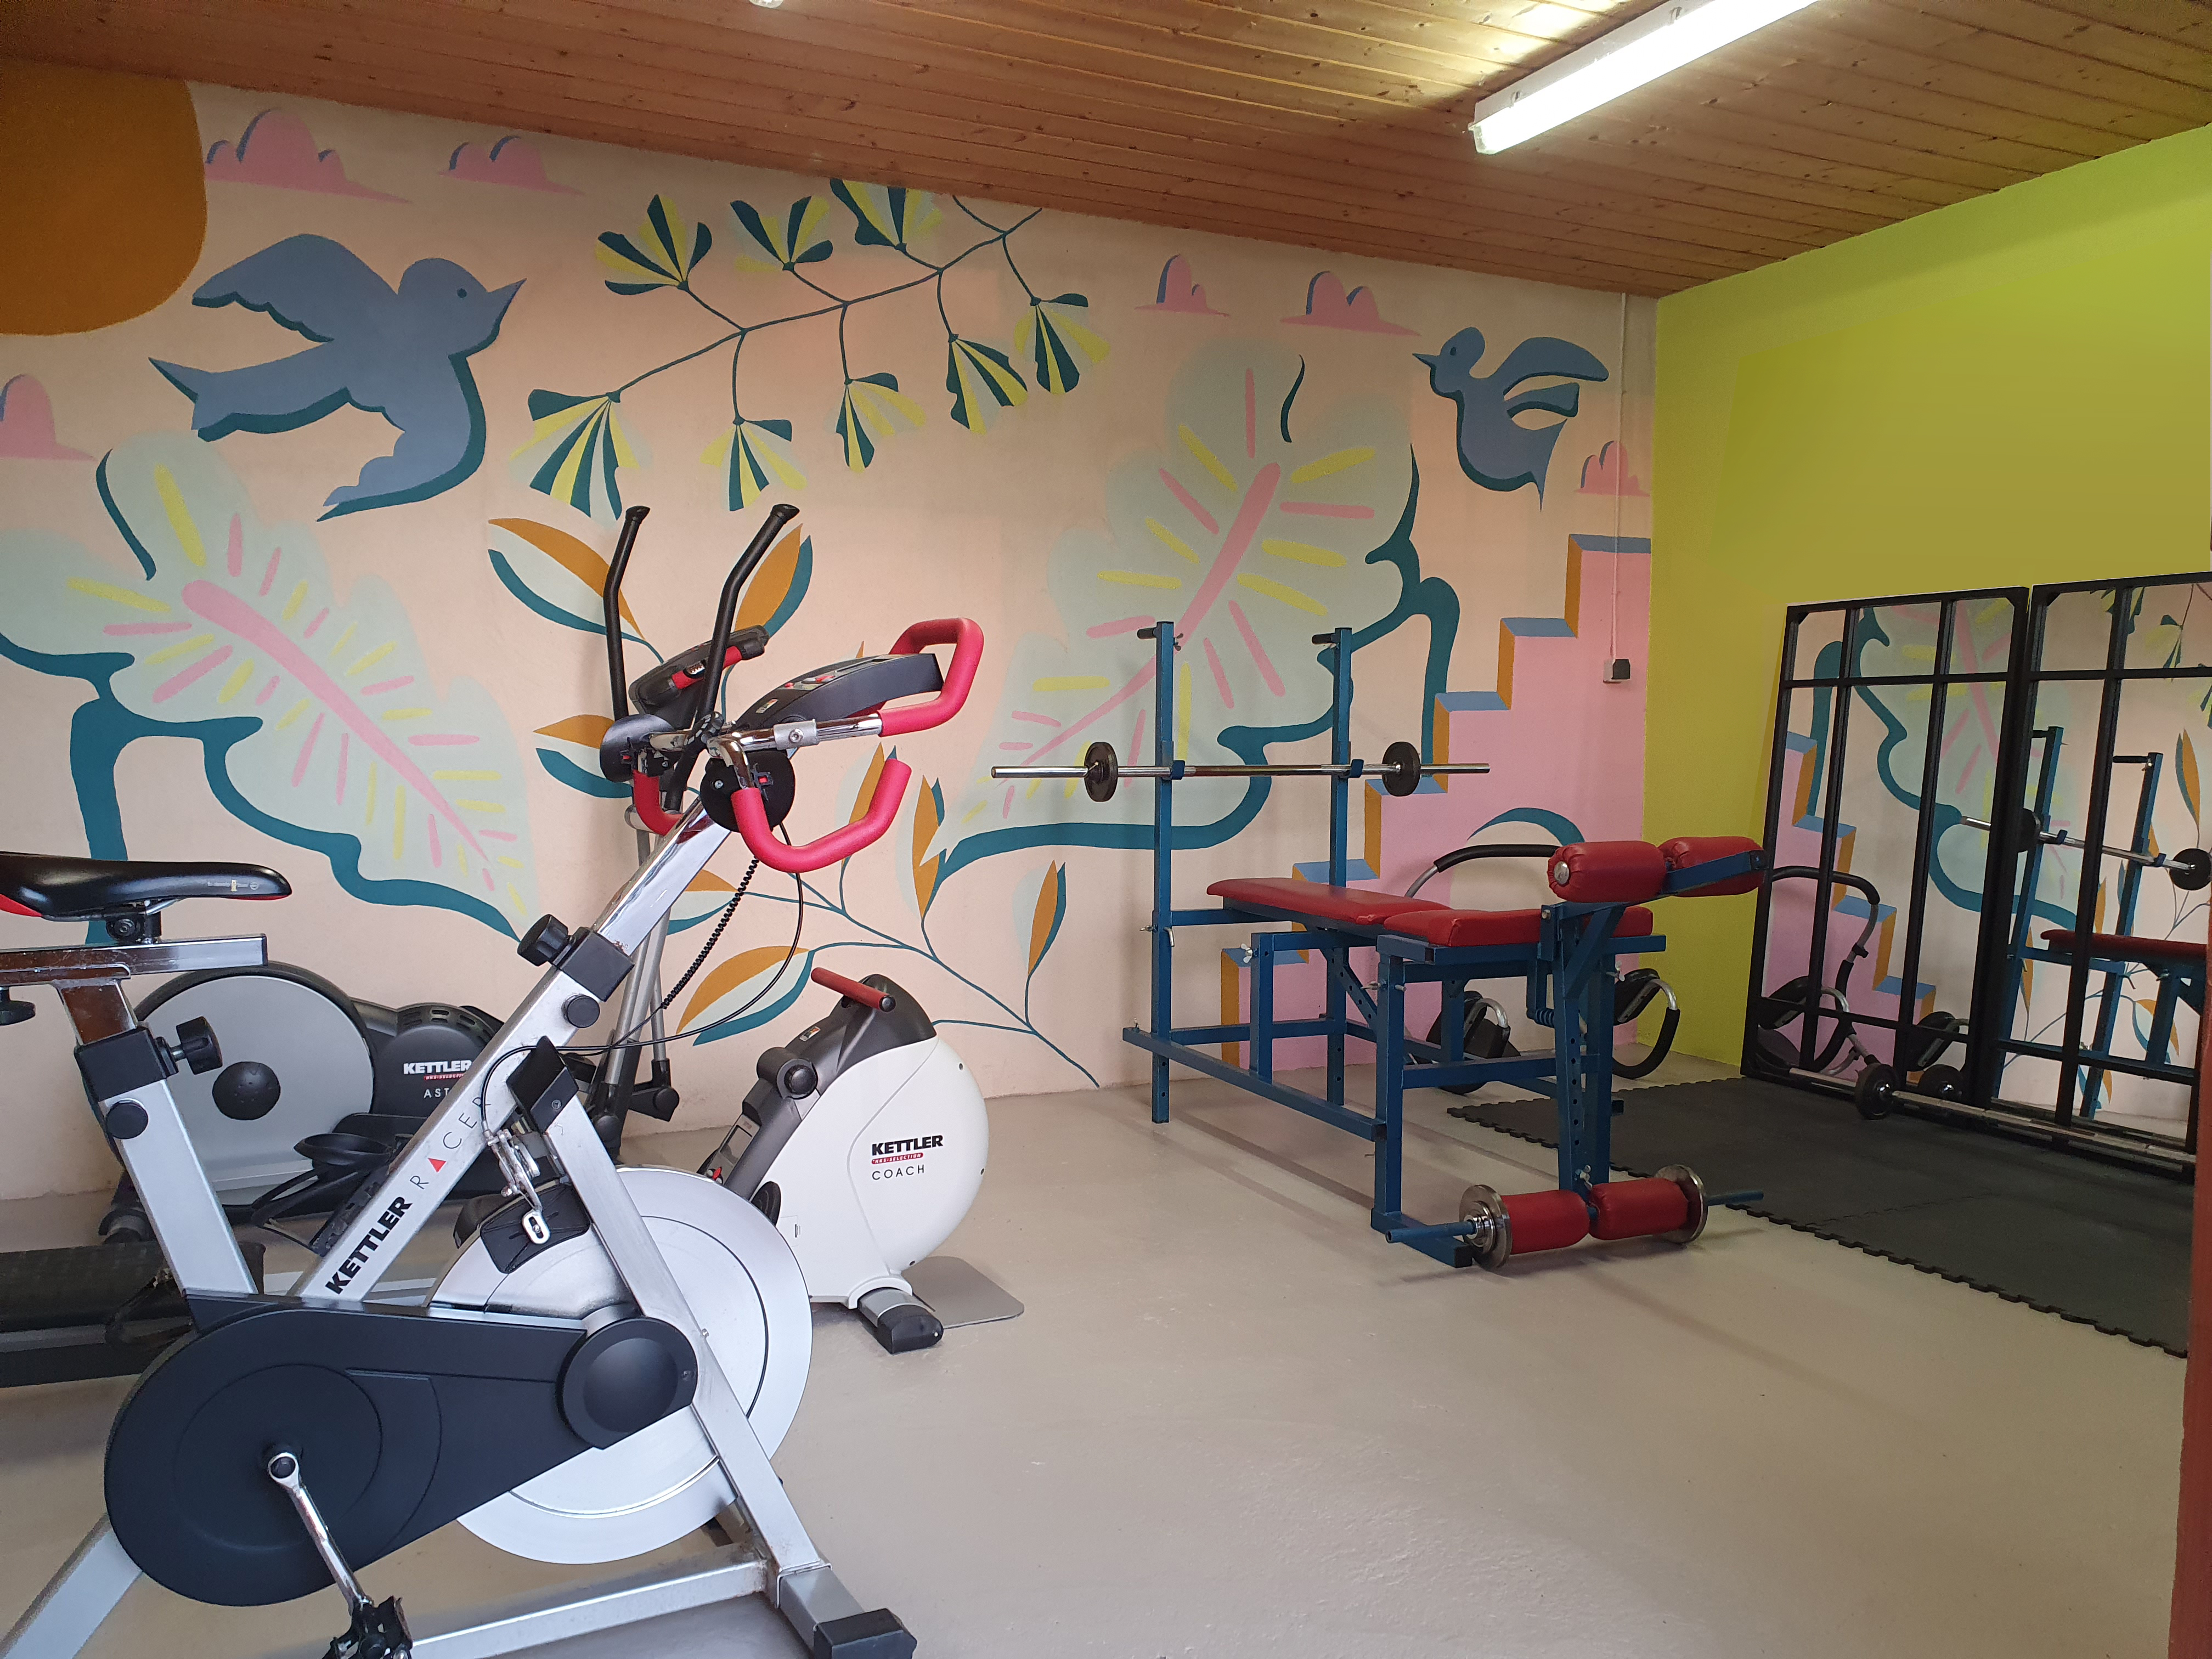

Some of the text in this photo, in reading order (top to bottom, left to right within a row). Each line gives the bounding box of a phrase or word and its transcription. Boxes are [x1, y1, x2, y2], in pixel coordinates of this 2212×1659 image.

[403, 1060, 472, 1075] KETTLER
[872, 1135, 944, 1156] KETTLER
[872, 1164, 924, 1180] COACH
[325, 1197, 413, 1295] KETTLER
